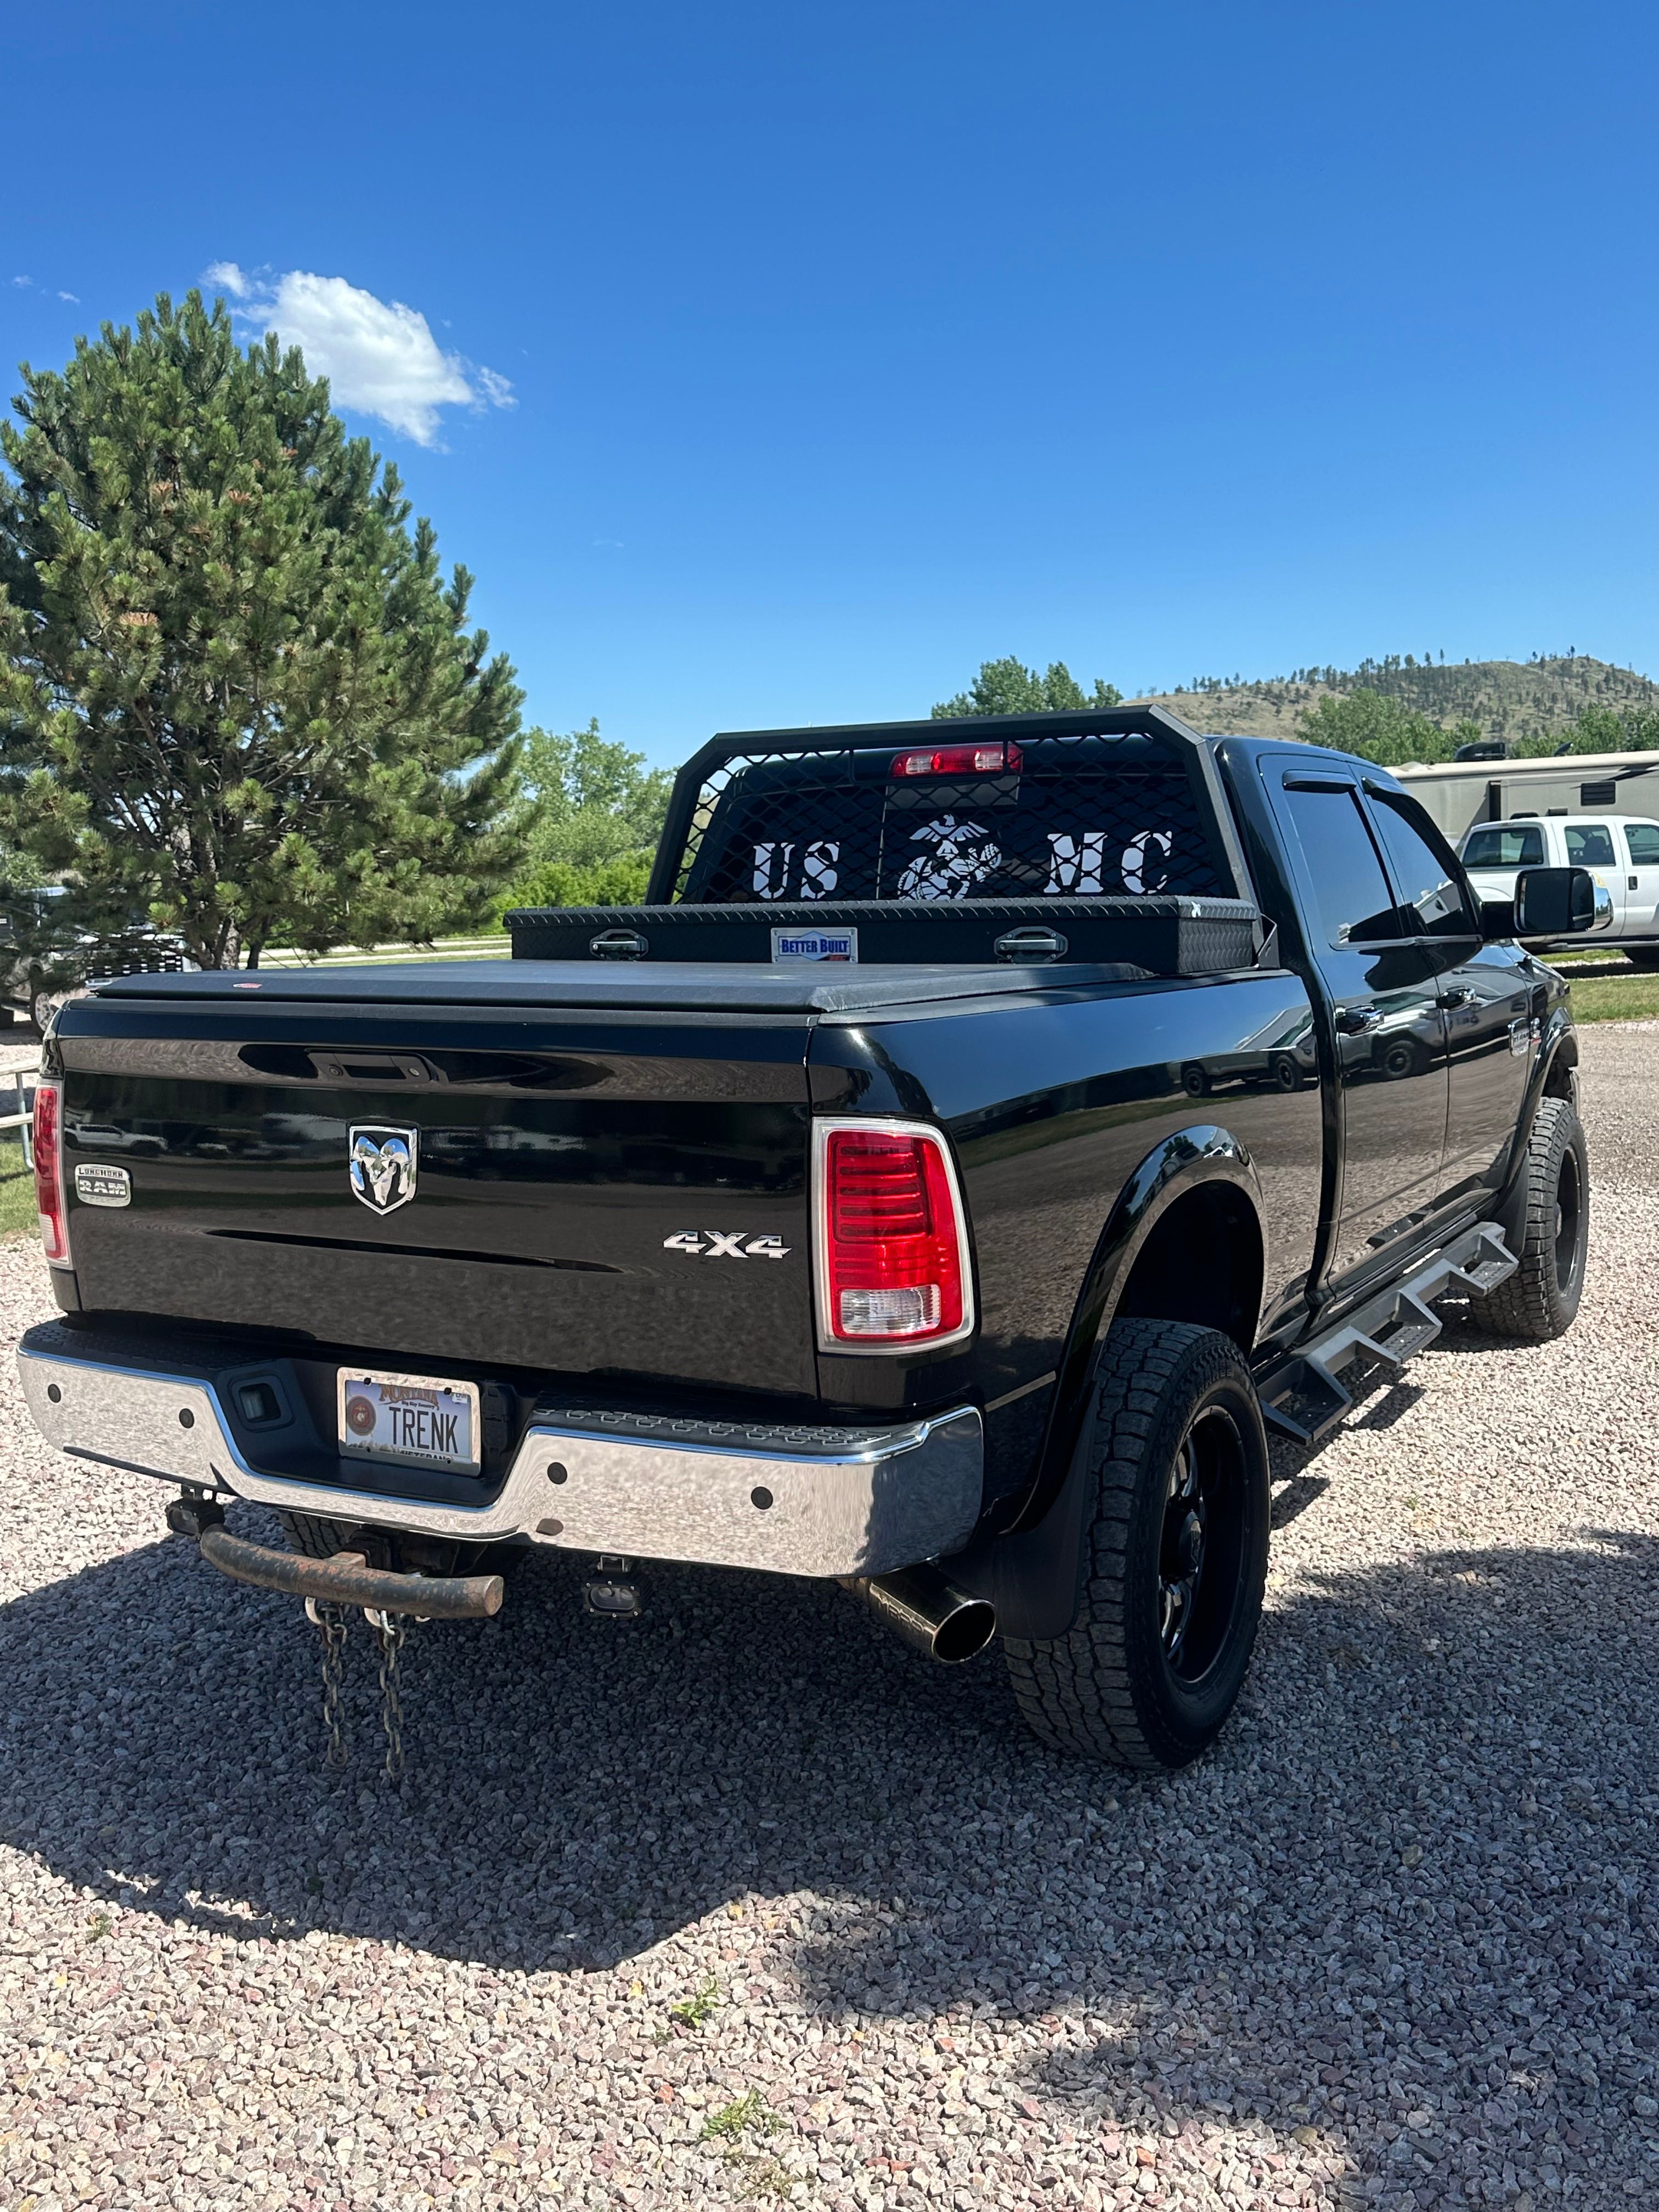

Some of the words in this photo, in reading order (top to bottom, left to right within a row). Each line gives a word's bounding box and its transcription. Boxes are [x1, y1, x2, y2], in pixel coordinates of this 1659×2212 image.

[781, 939, 817, 953] BETTER
[820, 939, 849, 953] BUILT
[78, 1167, 123, 1179] LONGHORN
[78, 1180, 127, 1195] RAM
[663, 1229, 793, 1259] 4X4
[379, 1384, 439, 1408] MONTANA
[388, 1406, 458, 1454] TRENK
